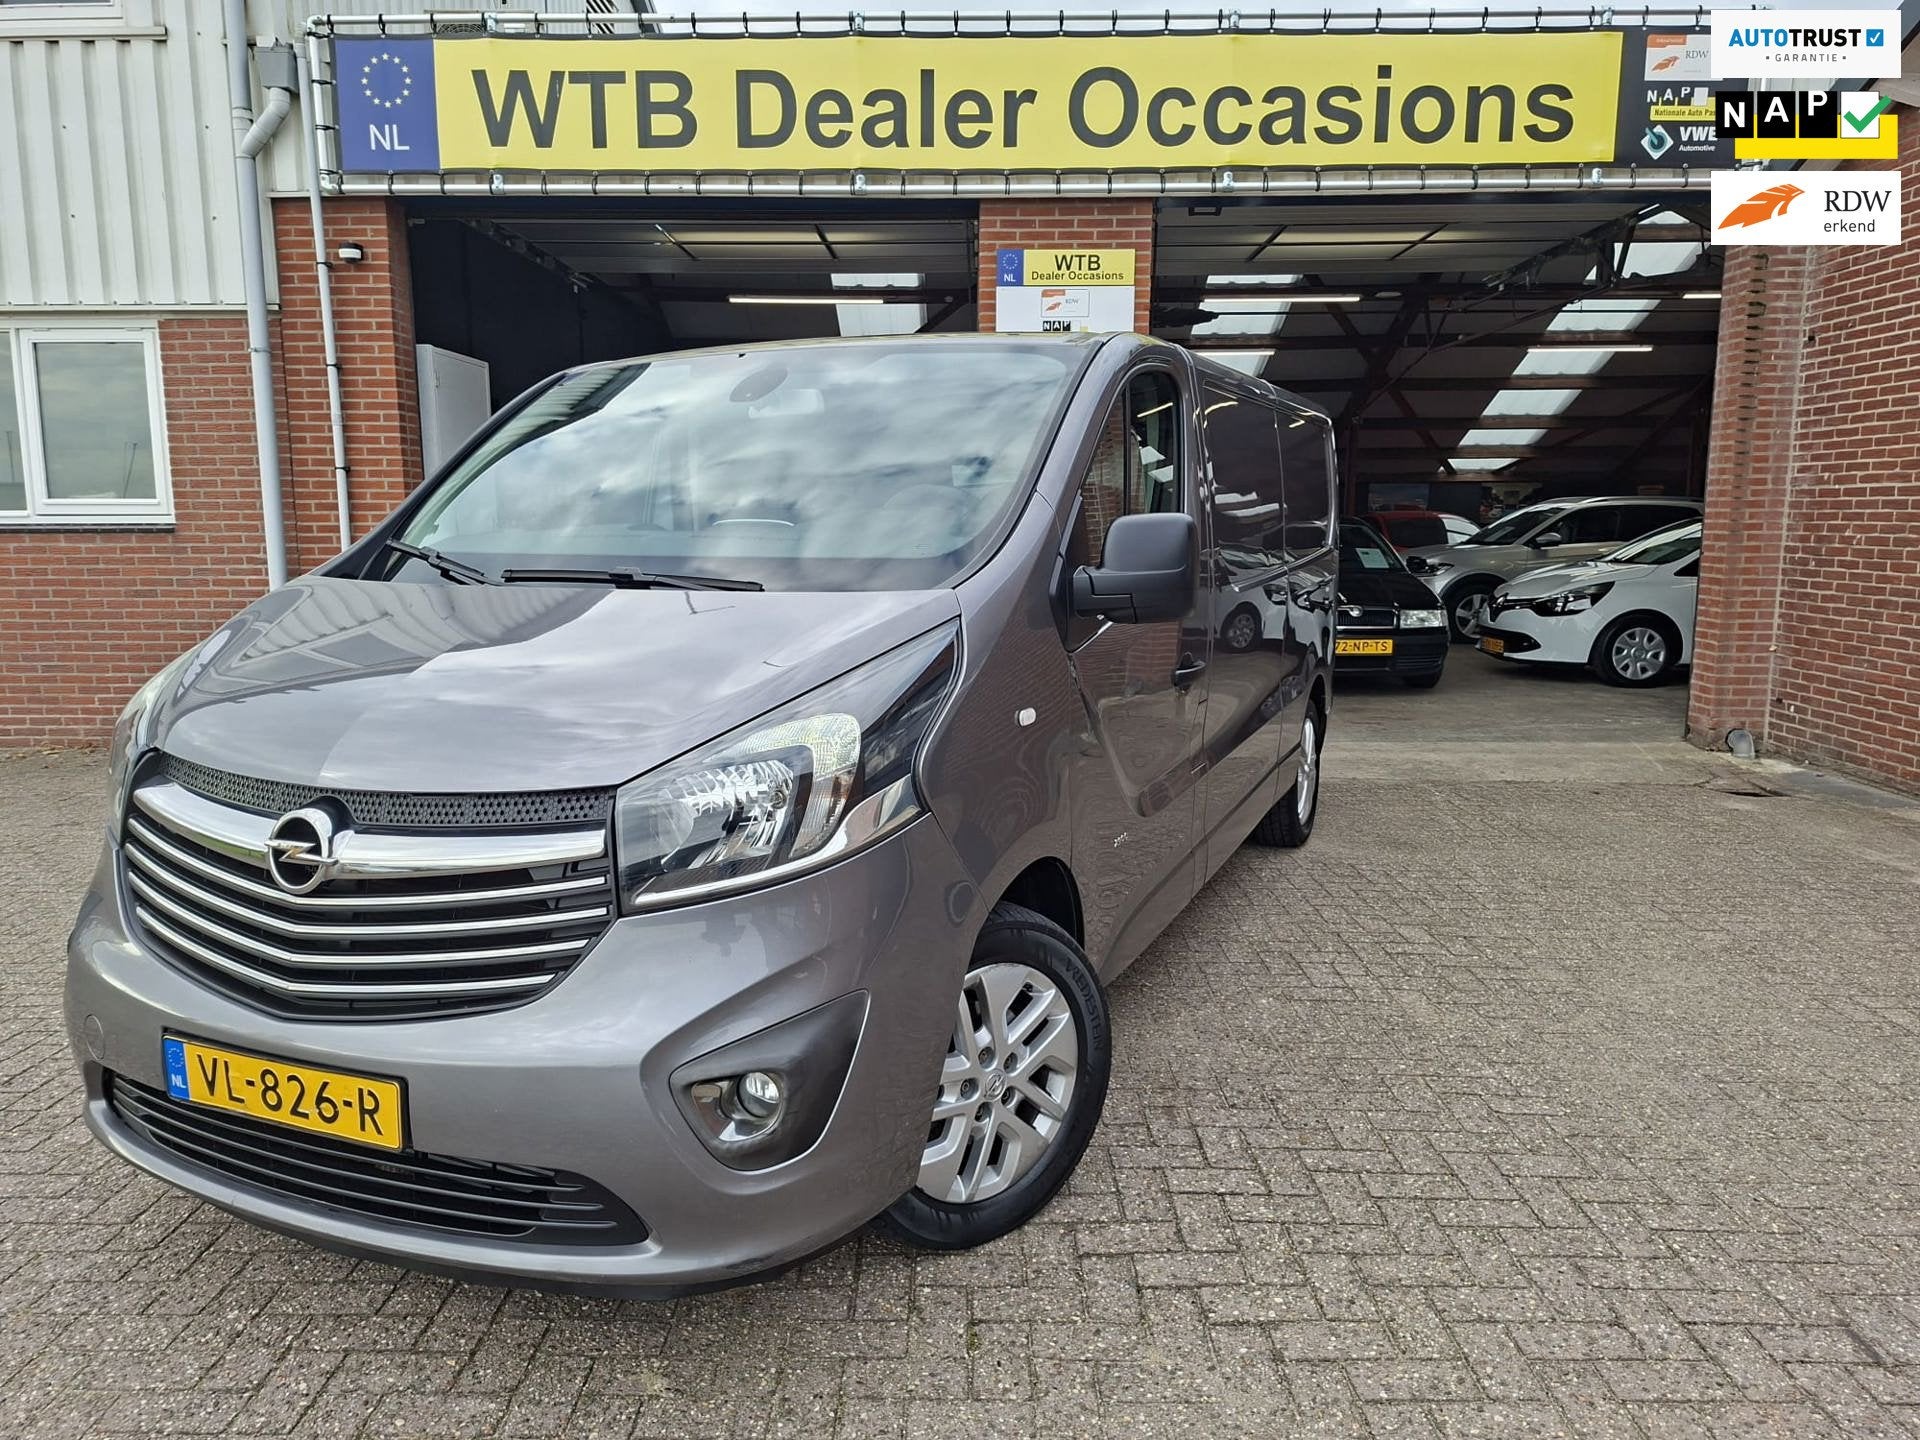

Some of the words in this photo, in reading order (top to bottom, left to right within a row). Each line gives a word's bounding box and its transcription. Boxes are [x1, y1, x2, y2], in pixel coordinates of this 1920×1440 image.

[1685, 50, 1709, 59] RDW
[471, 69, 698, 149] WTB
[735, 68, 1038, 149] Dealer
[1067, 64, 1575, 149] Occasions
[1654, 108, 1686, 117] Nationale
[1687, 108, 1703, 117] Auto
[369, 124, 410, 151] NL
[1679, 144, 1716, 152] Automotive
[1054, 254, 1101, 271] WTB
[1003, 273, 1016, 282] NL
[1031, 271, 1065, 281] Dealer
[1068, 271, 1124, 281] Occasions
[171, 1074, 187, 1089] NL
[197, 1054, 383, 1135] VL-826-R
